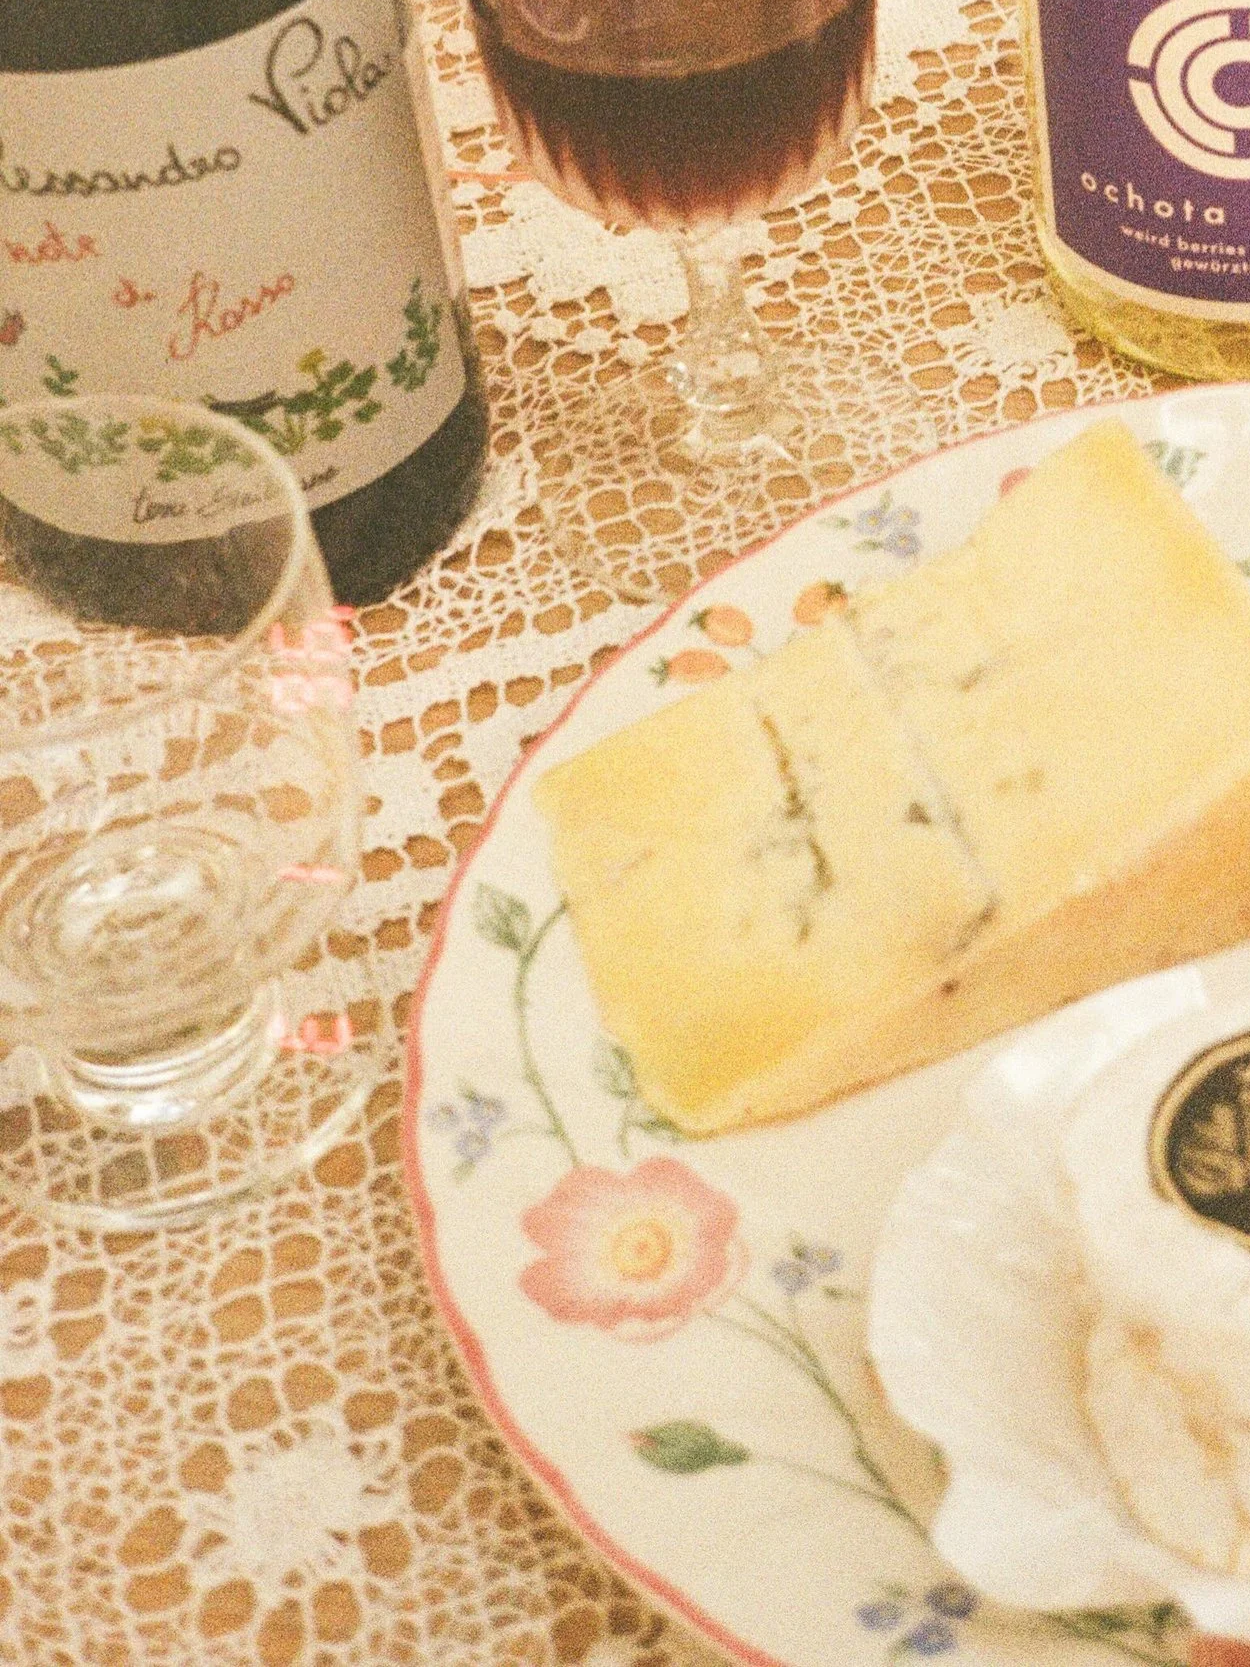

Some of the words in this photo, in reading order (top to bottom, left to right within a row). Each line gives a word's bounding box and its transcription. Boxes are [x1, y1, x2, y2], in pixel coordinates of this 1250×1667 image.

[248, 16, 391, 135] Viola
[1080, 172, 1225, 225] ochota
[1120, 224, 1171, 249] weird
[1177, 236, 1247, 257] berries
